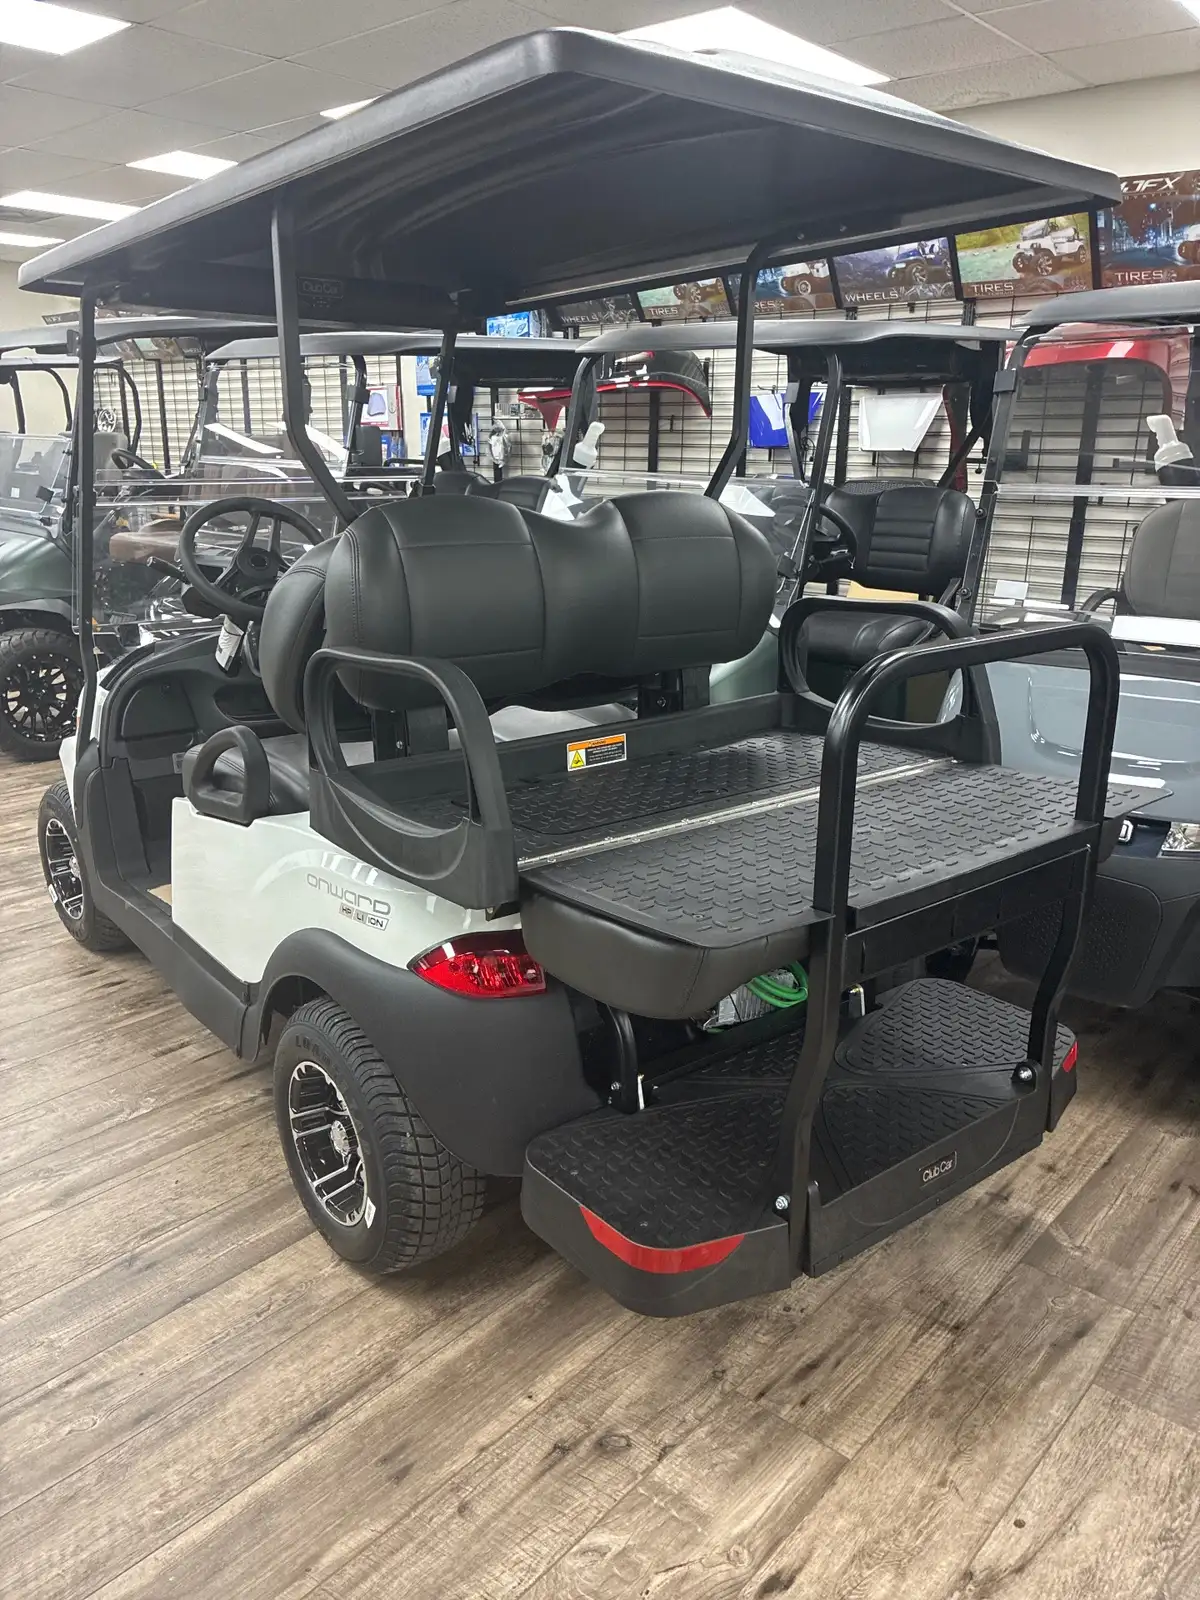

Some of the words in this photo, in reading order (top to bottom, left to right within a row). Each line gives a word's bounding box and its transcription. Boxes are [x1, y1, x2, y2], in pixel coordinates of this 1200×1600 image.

[1114, 270, 1163, 283] TIRES
[971, 282, 1014, 293] TIRES
[845, 290, 899, 302] WHEELS
[754, 300, 776, 310] RES
[649, 306, 679, 316] TIRES
[561, 313, 599, 324] WHEELS
[922, 1165, 940, 1182] Club
[940, 1159, 953, 1173] Car
